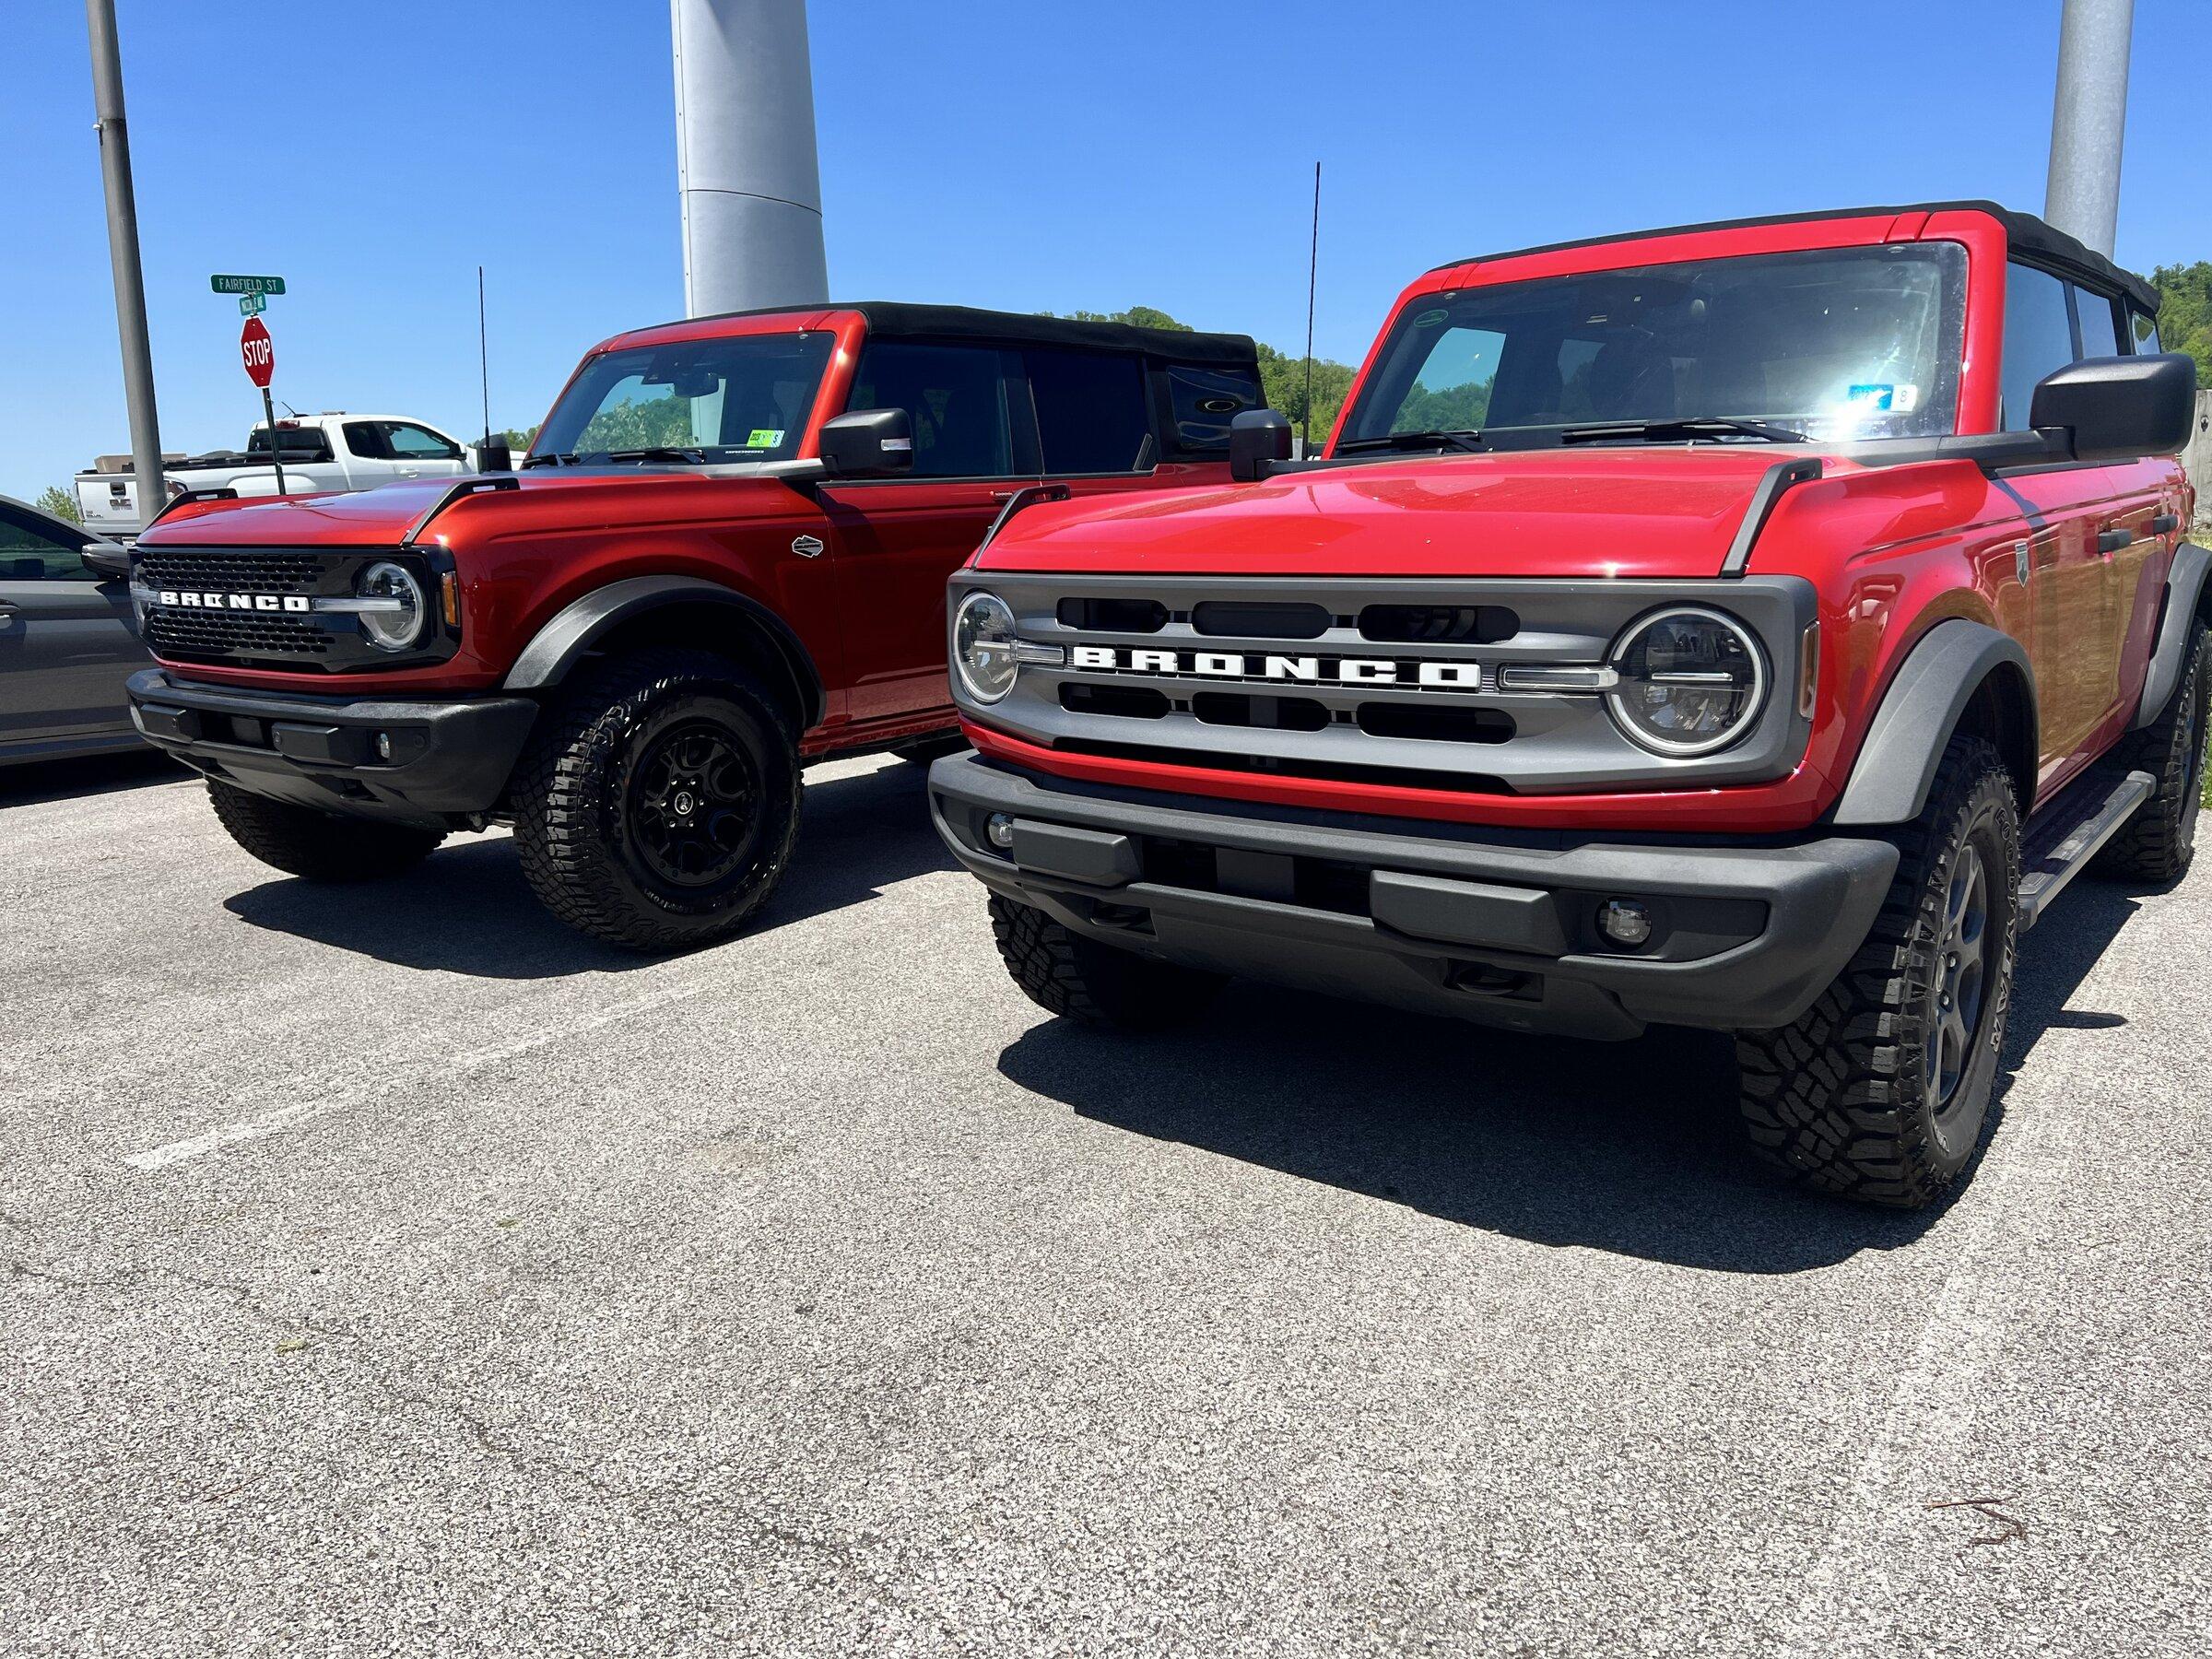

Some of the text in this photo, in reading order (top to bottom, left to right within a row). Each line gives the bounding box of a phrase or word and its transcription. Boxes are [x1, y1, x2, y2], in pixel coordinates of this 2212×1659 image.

[218, 277, 277, 291] FAIRFIELD ST
[243, 338, 271, 367] STOP
[159, 591, 310, 612] BRONCO
[1073, 646, 1481, 688] BRONCO
[1990, 806, 2018, 1053] GOODYEAR
